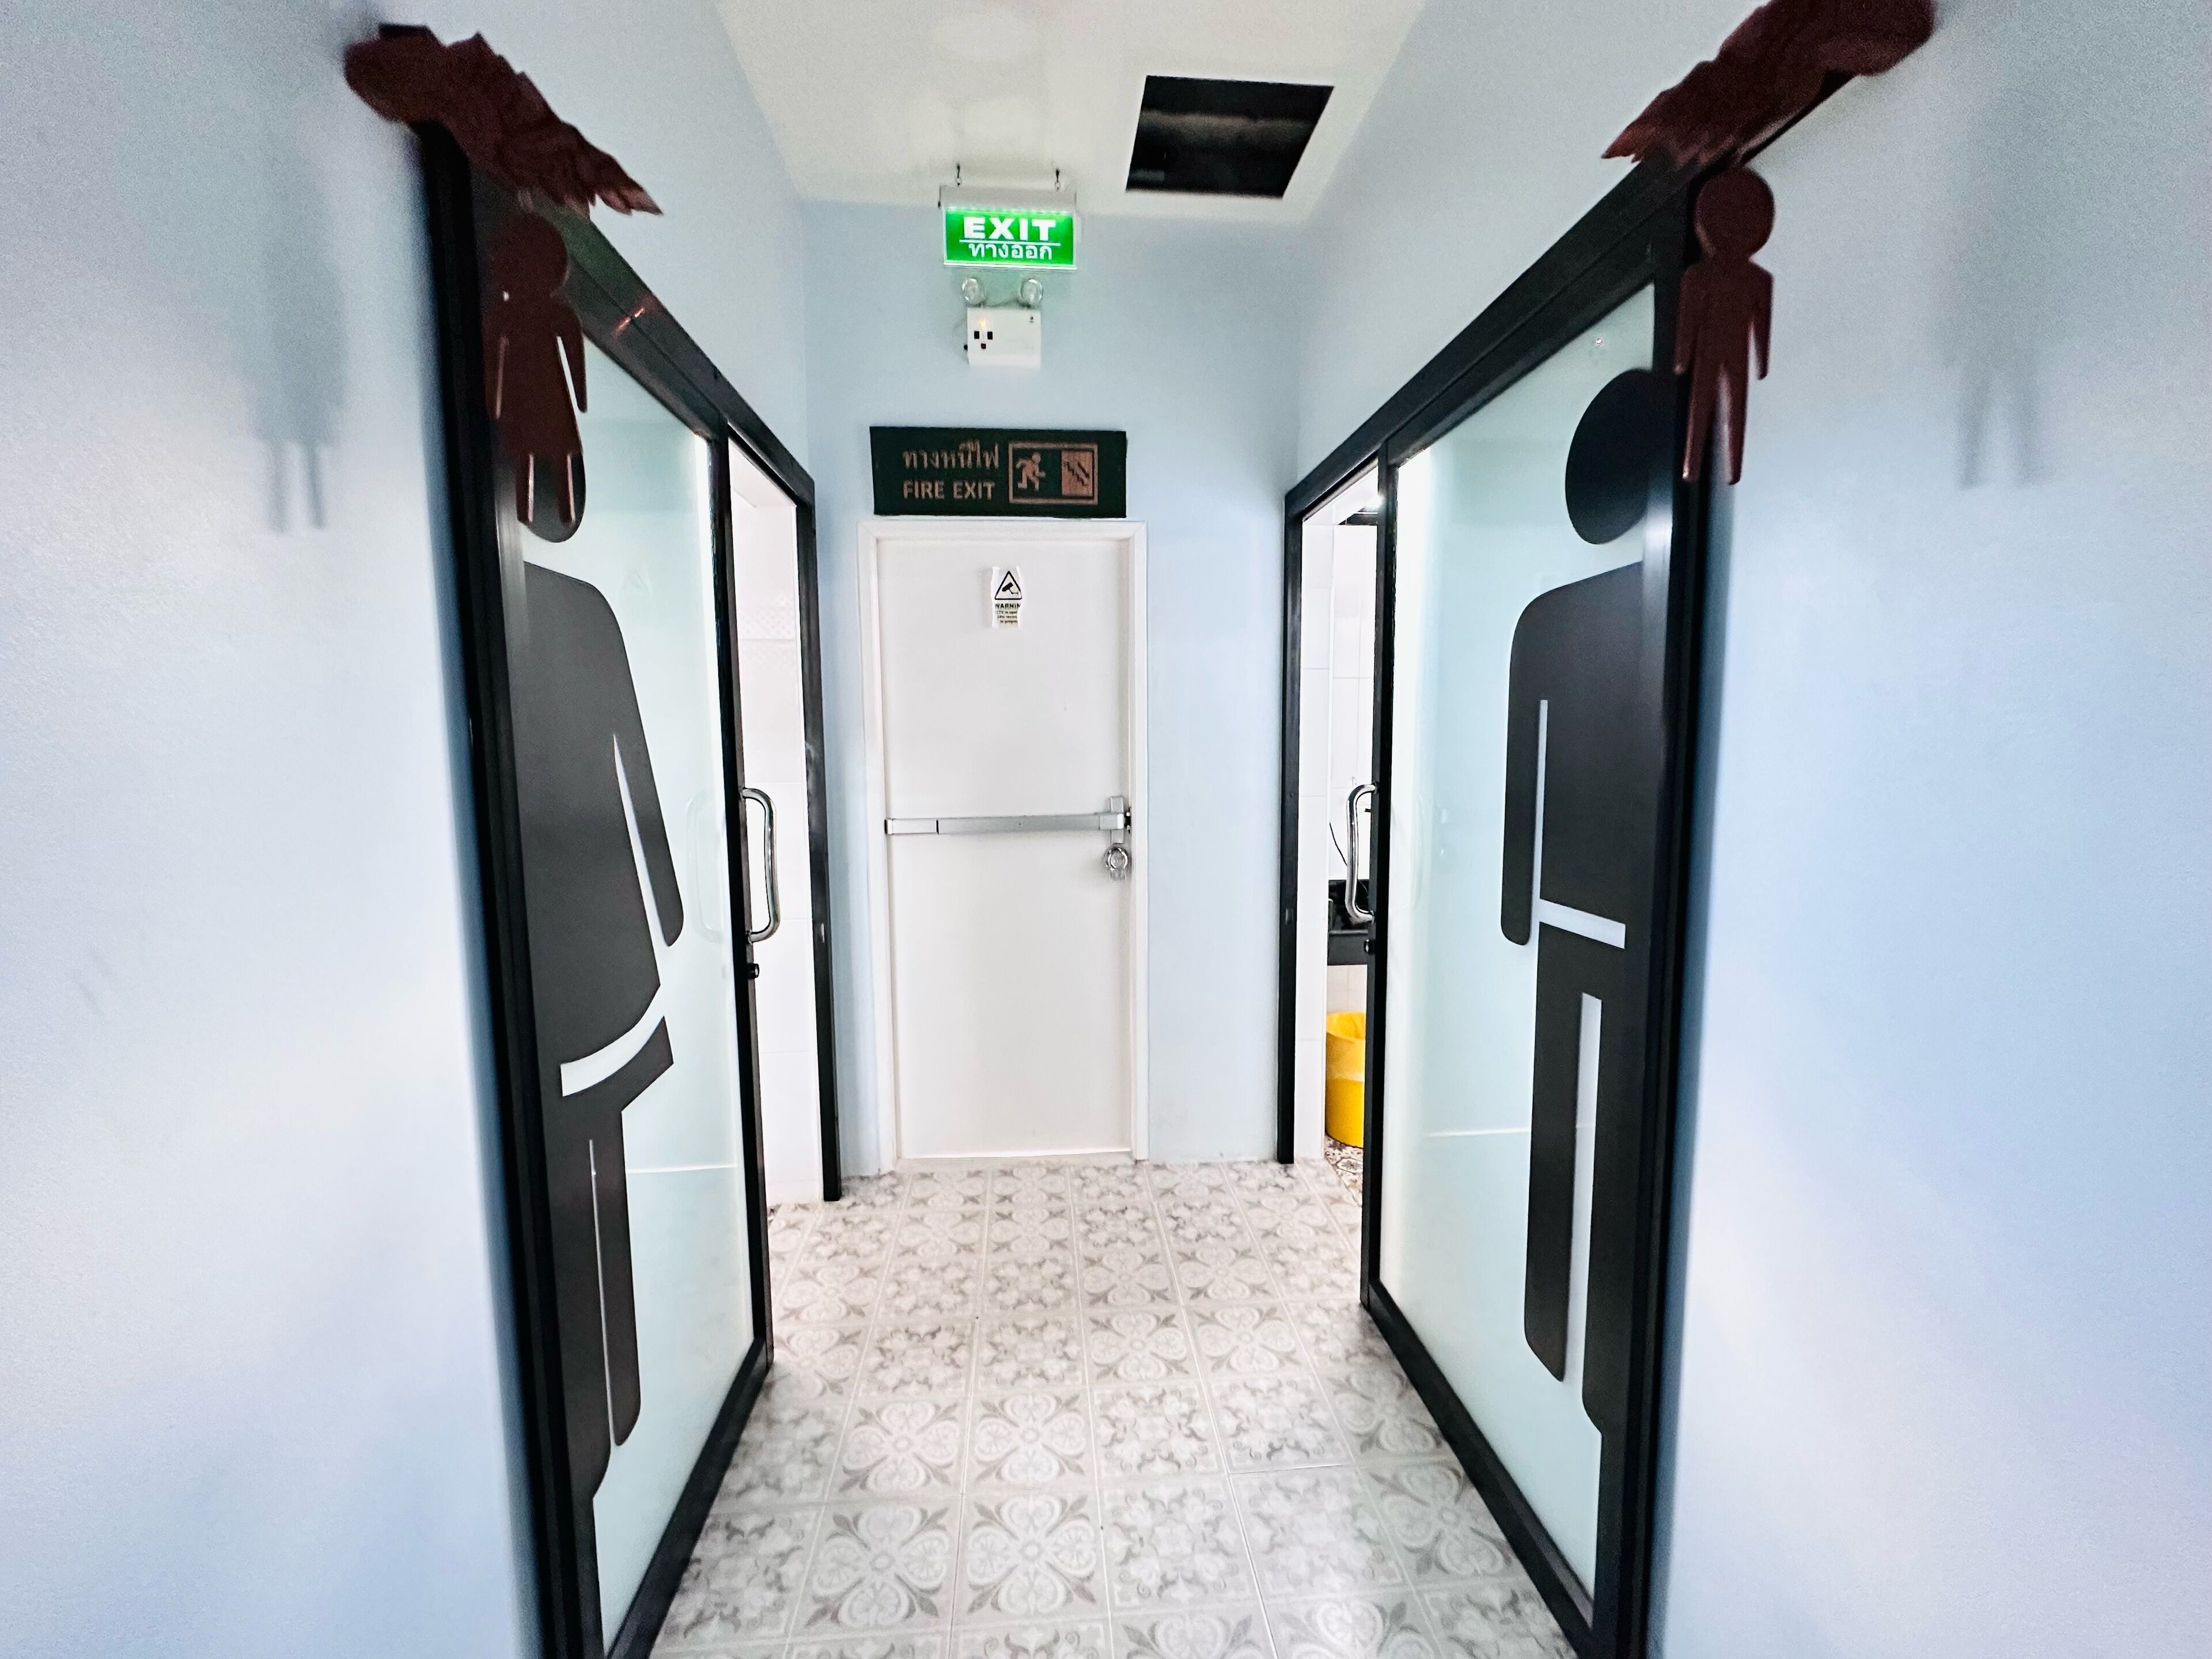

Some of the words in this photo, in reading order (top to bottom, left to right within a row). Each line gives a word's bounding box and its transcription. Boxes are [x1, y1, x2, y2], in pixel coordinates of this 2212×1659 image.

[964, 216, 1056, 241] EXIT
[968, 243, 1052, 260] ทางออก
[903, 439, 999, 470] ทางหนีไฟ
[903, 480, 945, 499] FIRE
[953, 480, 995, 500] EXIT
